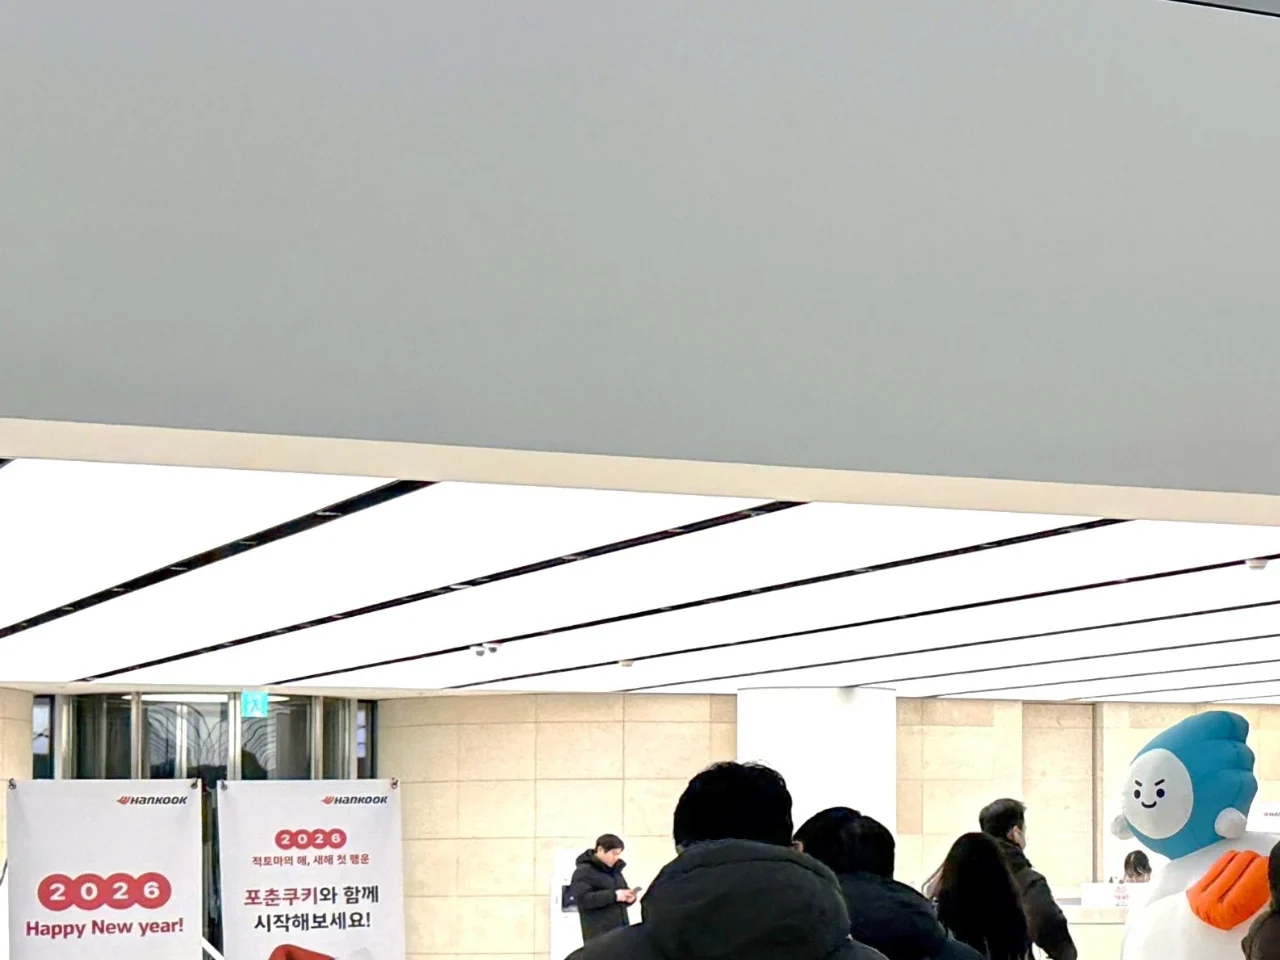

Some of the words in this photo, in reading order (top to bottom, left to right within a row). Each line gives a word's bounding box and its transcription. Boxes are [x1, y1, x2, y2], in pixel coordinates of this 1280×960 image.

[281, 833, 341, 845] 2026
[252, 855, 293, 867] 적토마의
[296, 855, 310, 867] 해,
[313, 854, 334, 866] 새해
[337, 853, 347, 865] 첫
[350, 853, 370, 865] 행운
[49, 881, 161, 901] 2026
[244, 886, 338, 906] 포춘쿠키와
[343, 885, 379, 904] 함께
[26, 920, 87, 939] Happy
[91, 919, 133, 935] New
[138, 917, 184, 937] year!
[254, 912, 371, 932] 시작해보세요!
